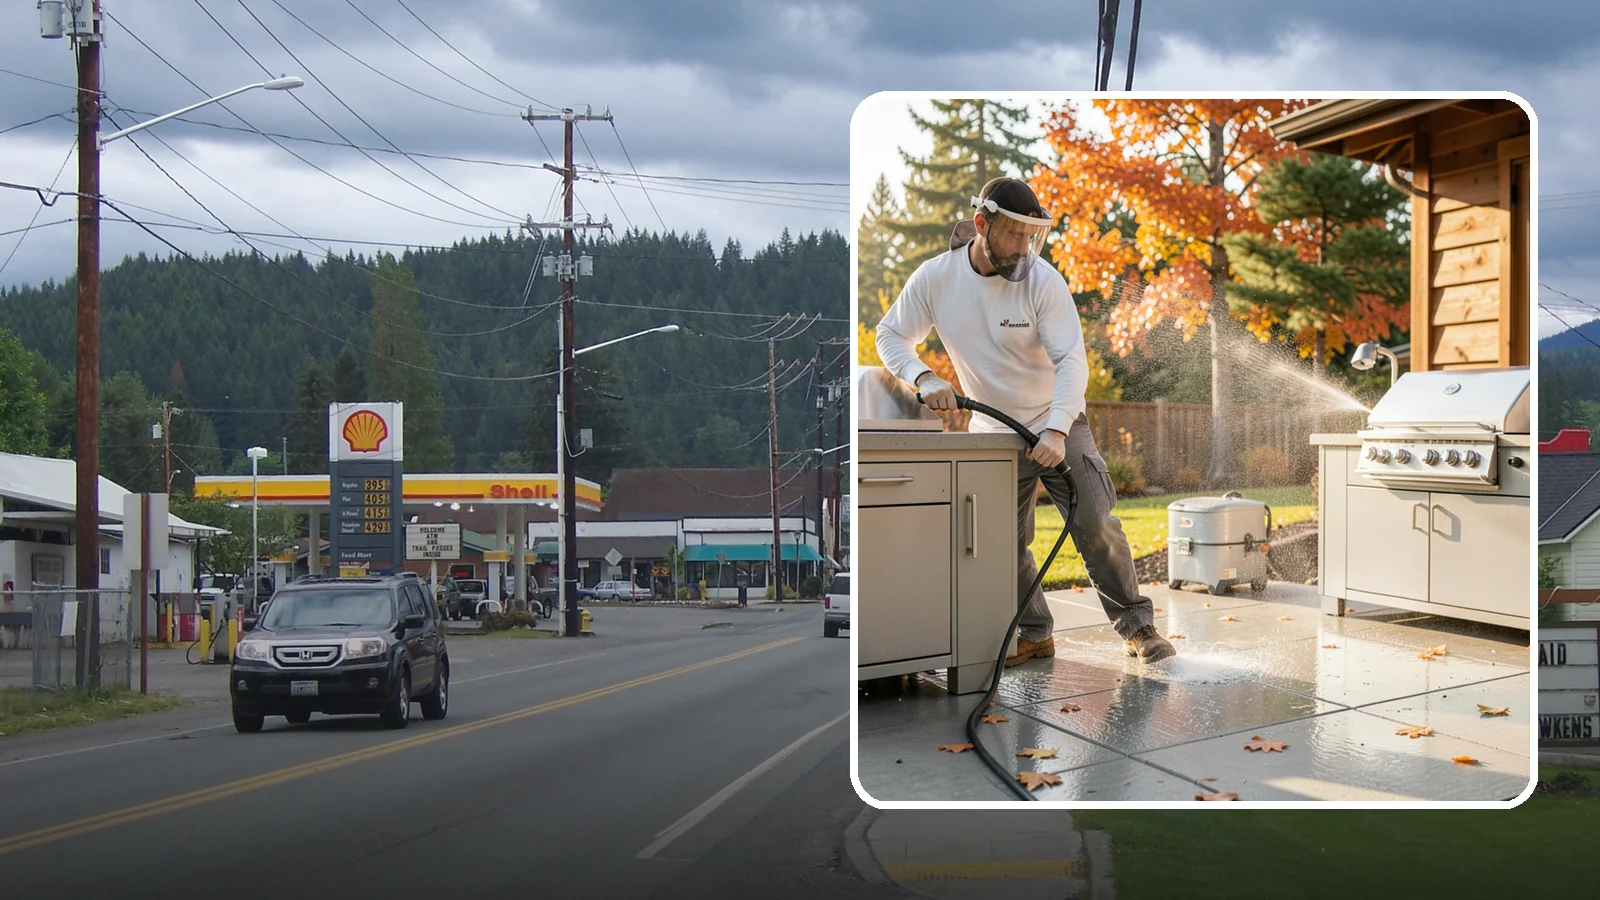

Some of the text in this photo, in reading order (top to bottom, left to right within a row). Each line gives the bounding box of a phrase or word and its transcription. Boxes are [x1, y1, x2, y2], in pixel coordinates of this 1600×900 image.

[366, 480, 384, 490] 395
[490, 484, 547, 499] Shell
[366, 494, 384, 504] 405
[366, 508, 384, 518] 415
[366, 522, 384, 533] 429
